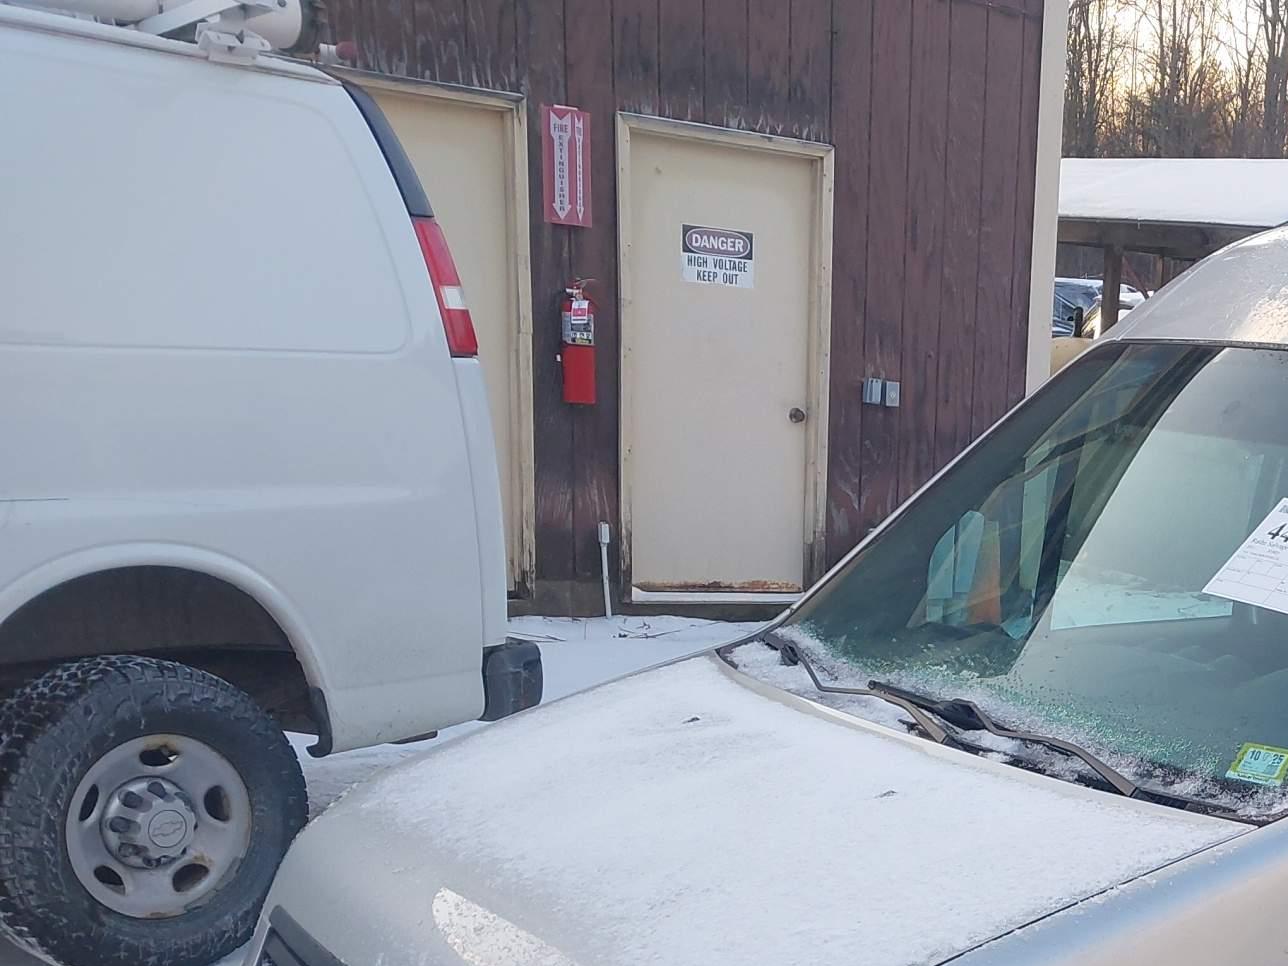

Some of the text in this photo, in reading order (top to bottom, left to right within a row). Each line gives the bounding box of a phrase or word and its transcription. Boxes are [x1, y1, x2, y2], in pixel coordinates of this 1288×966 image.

[553, 123, 568, 133] FIRE
[691, 233, 744, 252] DANGER
[687, 254, 748, 272] HIGH VOLTAGE
[696, 269, 739, 285] KEEP OUT
[1250, 750, 1284, 764] 10 25
